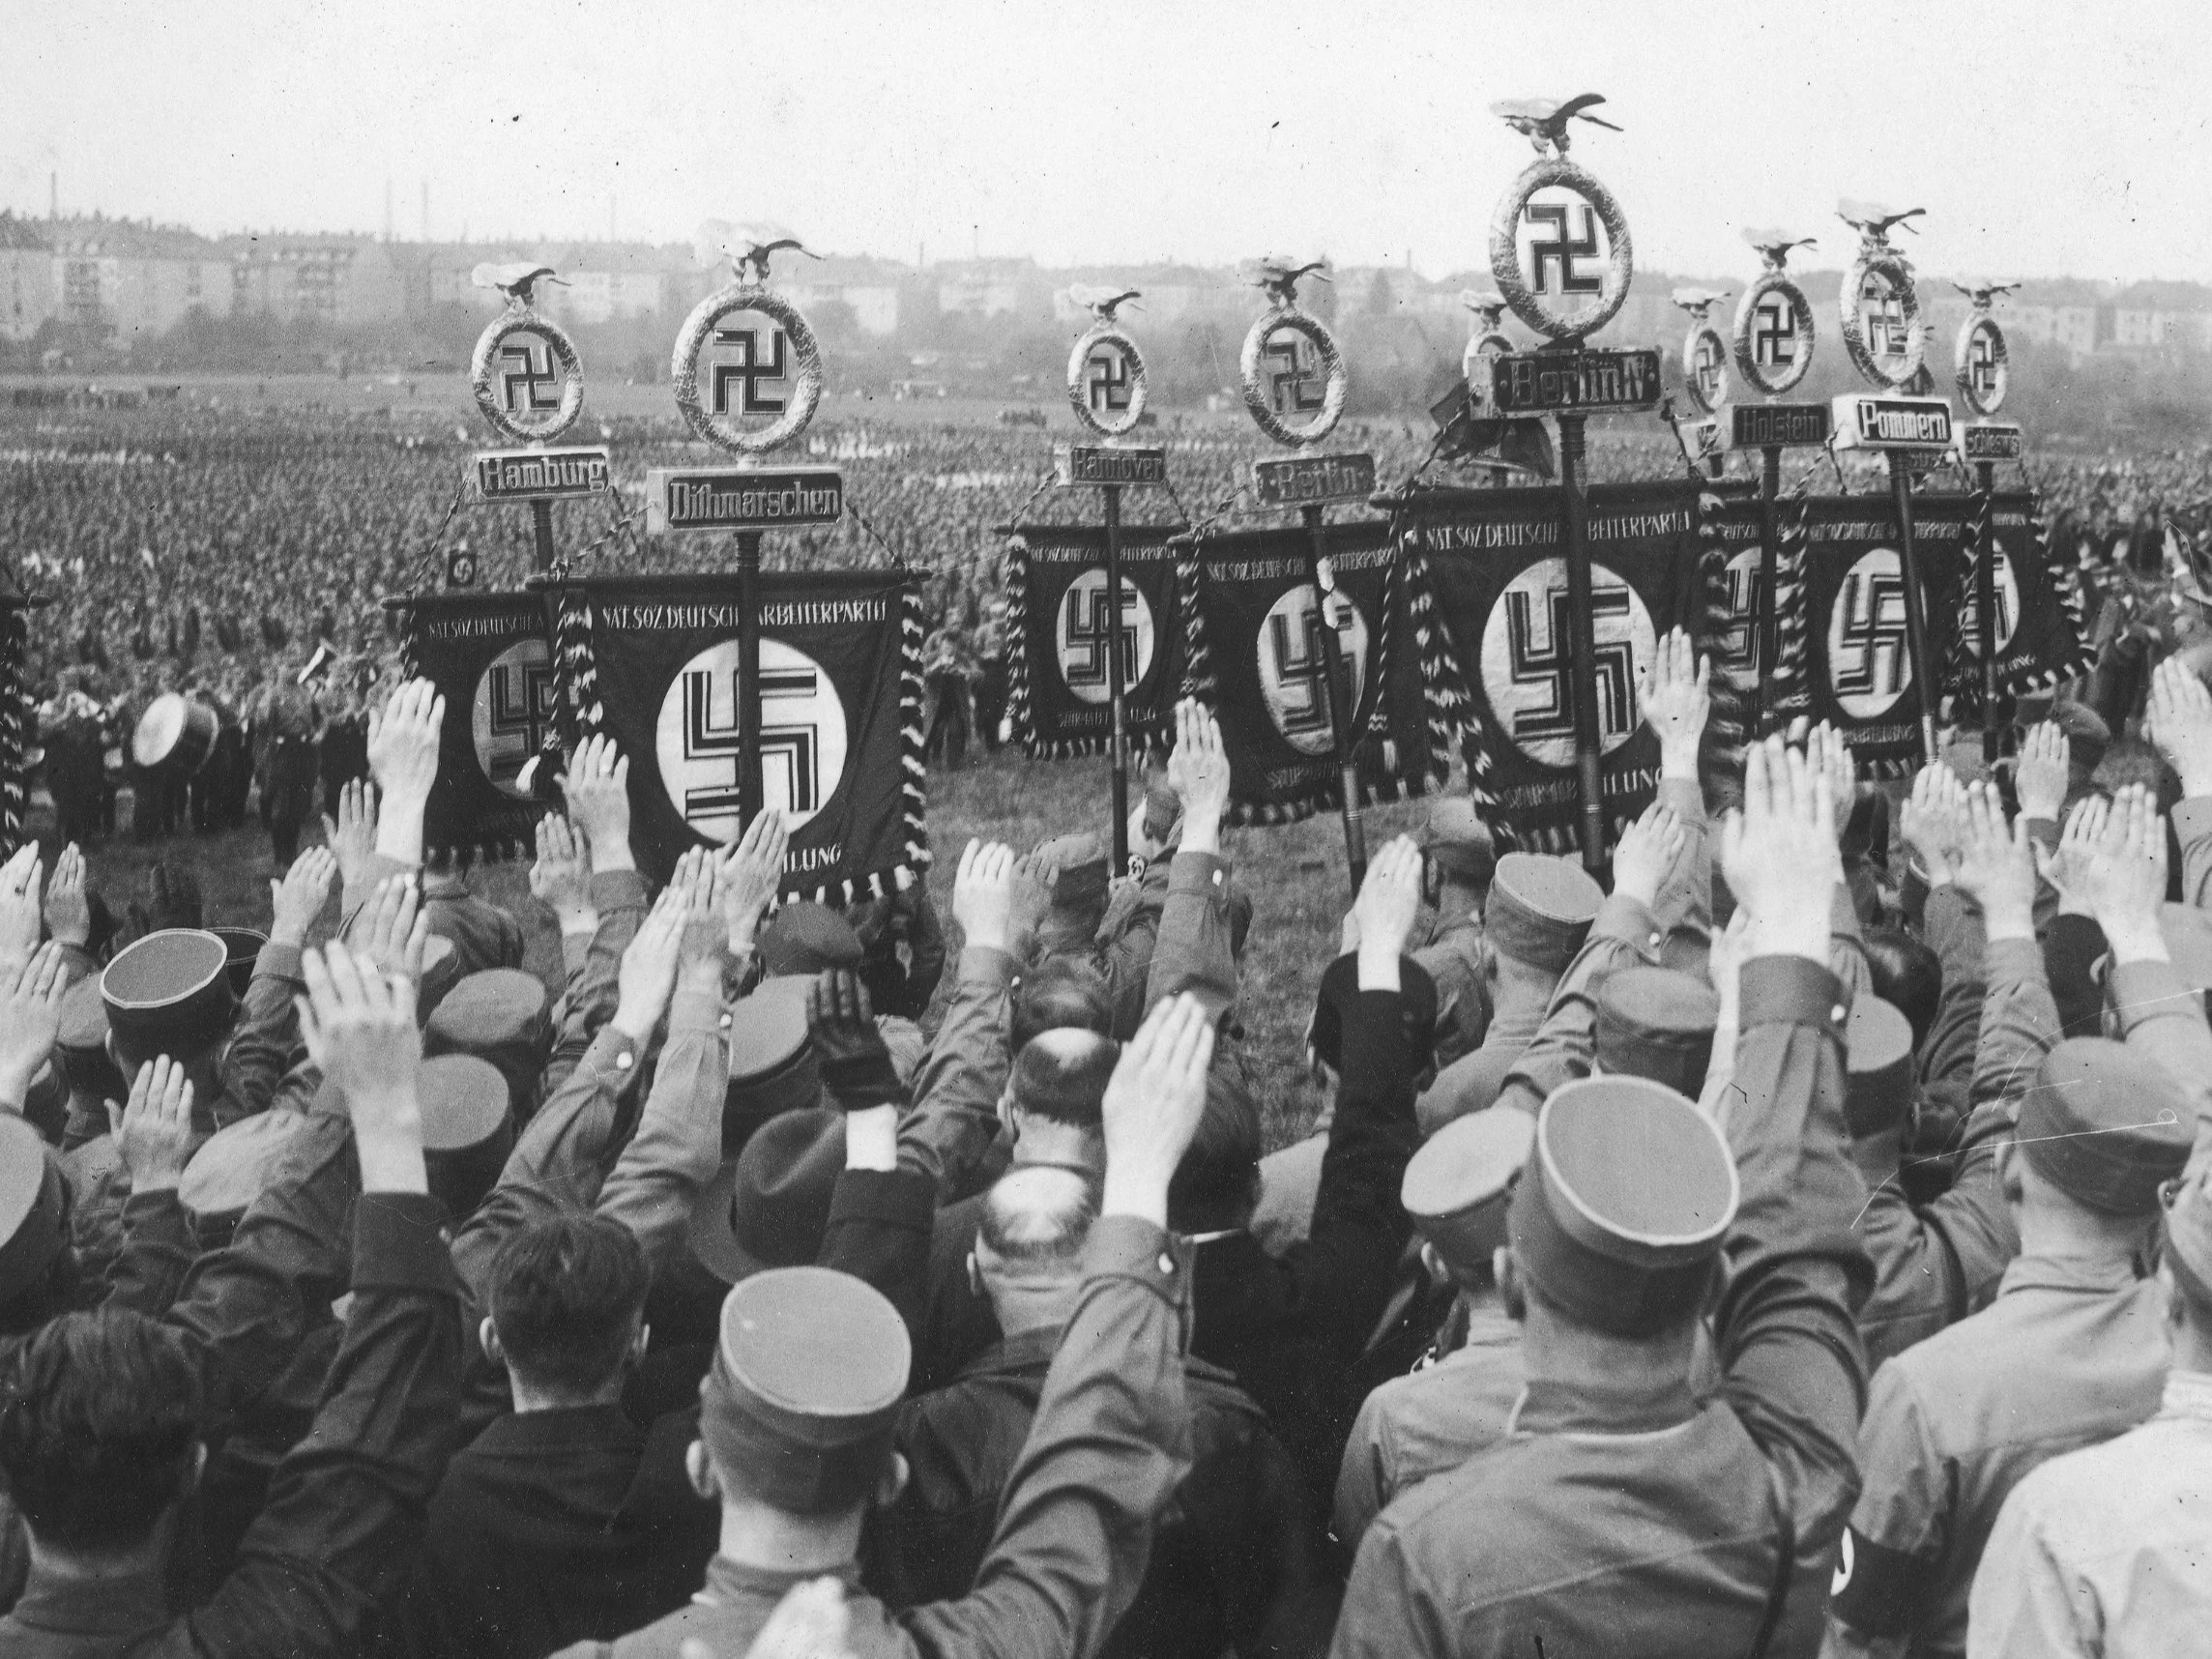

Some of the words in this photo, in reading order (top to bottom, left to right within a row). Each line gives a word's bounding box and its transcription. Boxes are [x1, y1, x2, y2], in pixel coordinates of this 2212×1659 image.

[1509, 357, 1621, 406] Berlin
[1742, 409, 1820, 442] Holstein
[1858, 400, 1949, 440] Pommern
[481, 456, 606, 492] Hamburg
[670, 480, 840, 520] Dithmarschen
[1587, 509, 1691, 541] BEITERPARTEI
[667, 601, 739, 629] DEUTSCH
[759, 598, 887, 626] RBEITERPARTEI
